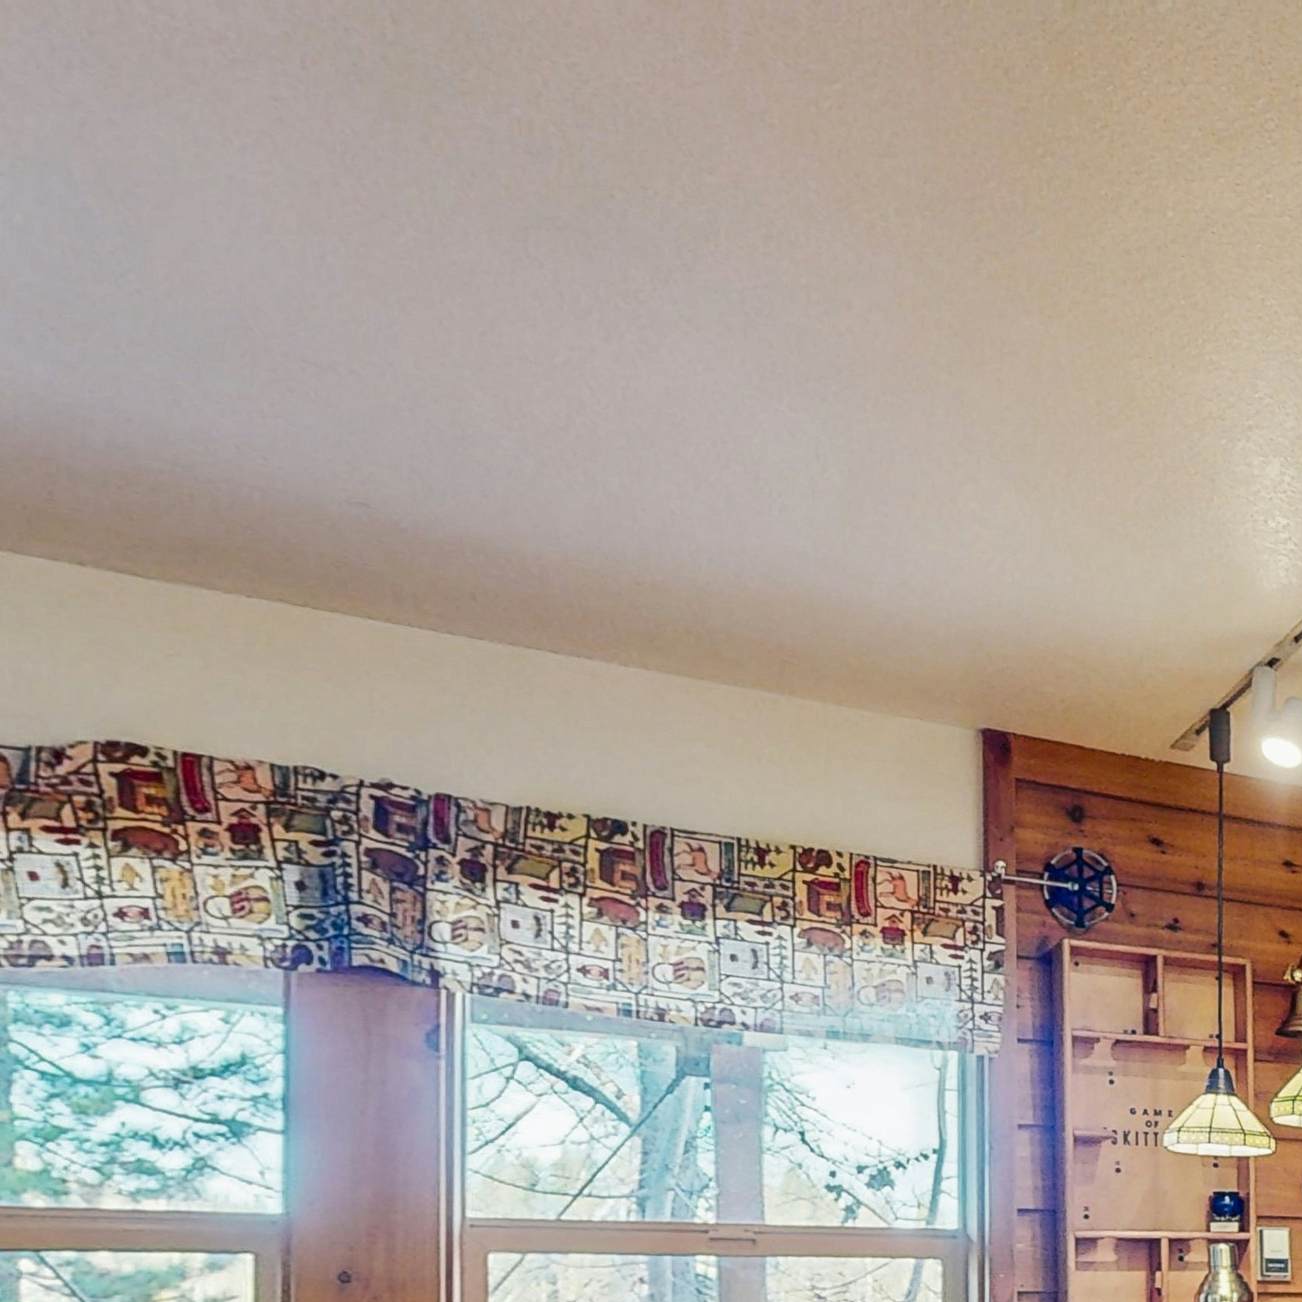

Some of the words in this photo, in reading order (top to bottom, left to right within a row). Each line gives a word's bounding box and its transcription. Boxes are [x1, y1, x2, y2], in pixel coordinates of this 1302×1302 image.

[1129, 1107, 1174, 1118] GAME
[1145, 1120, 1159, 1128] OF
[1111, 1130, 1160, 1147] SKITT
